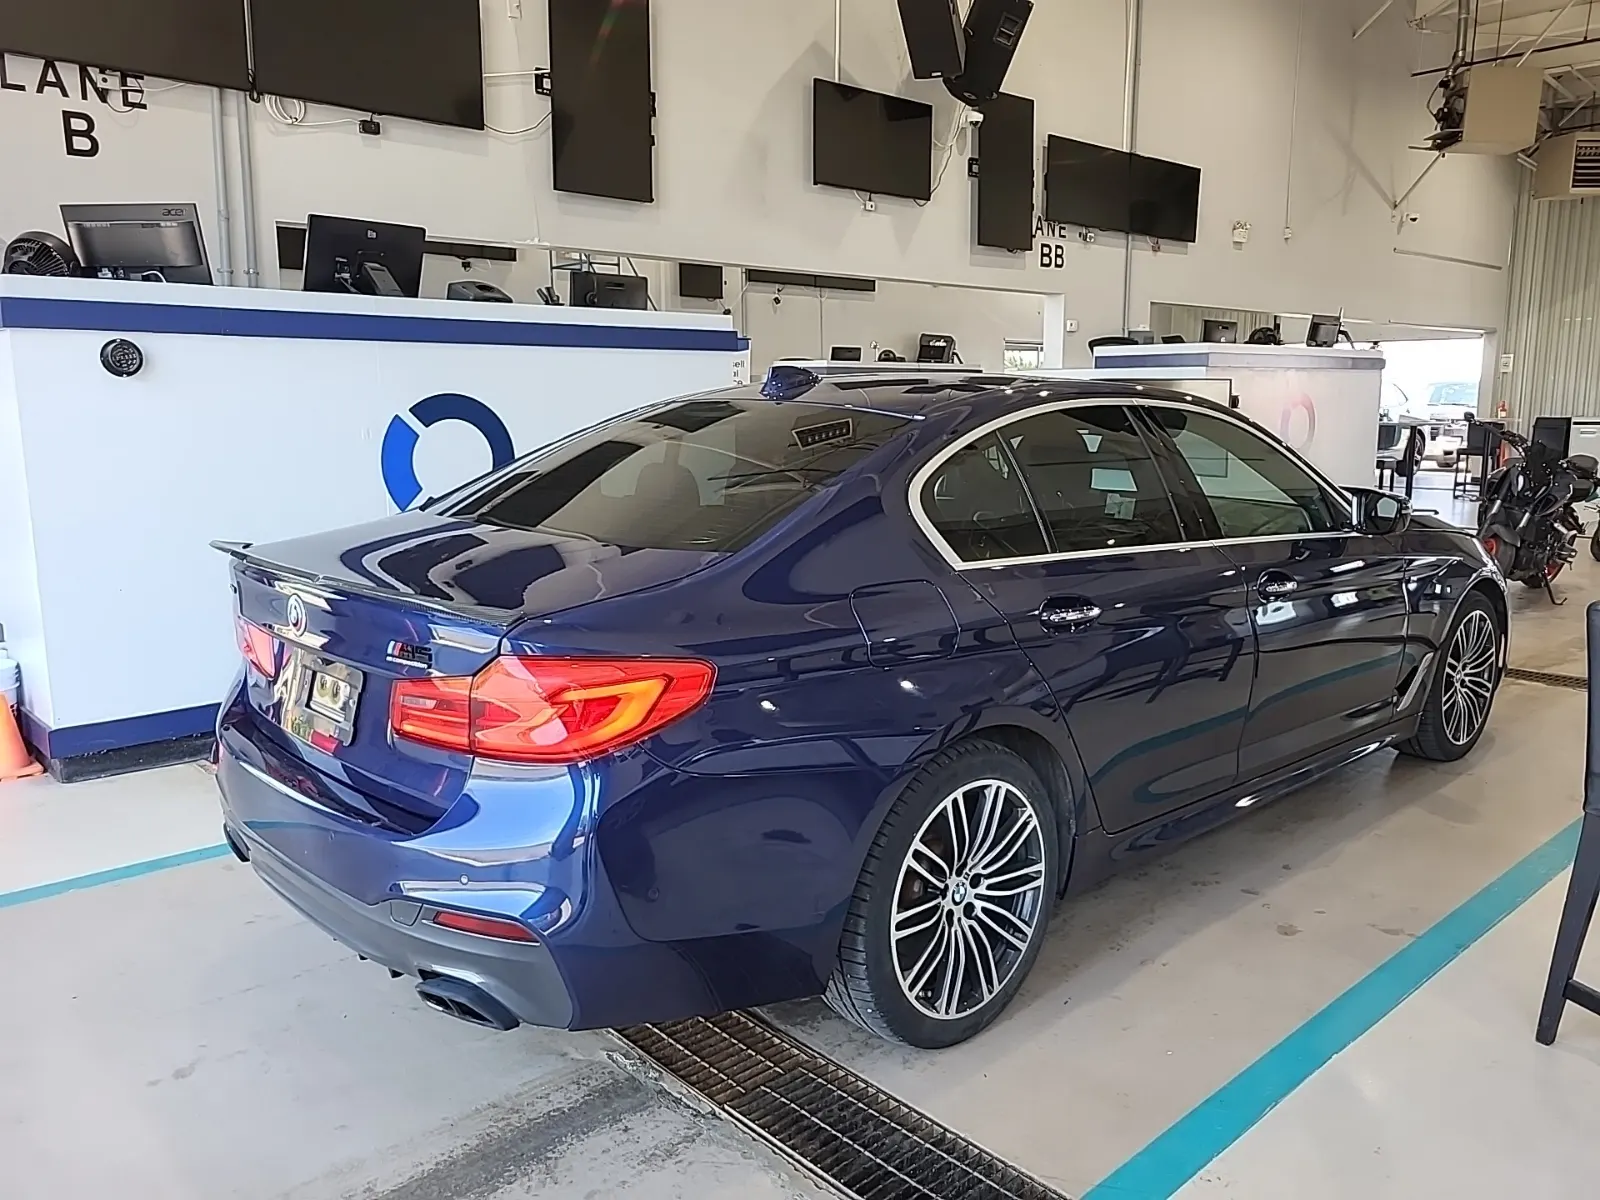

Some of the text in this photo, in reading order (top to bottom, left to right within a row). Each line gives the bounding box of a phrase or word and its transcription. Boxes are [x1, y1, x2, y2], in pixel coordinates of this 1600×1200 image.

[0, 52, 148, 110] LANE
[61, 109, 100, 158] B
[1032, 215, 1067, 239] ANE
[1040, 243, 1065, 268] BB
